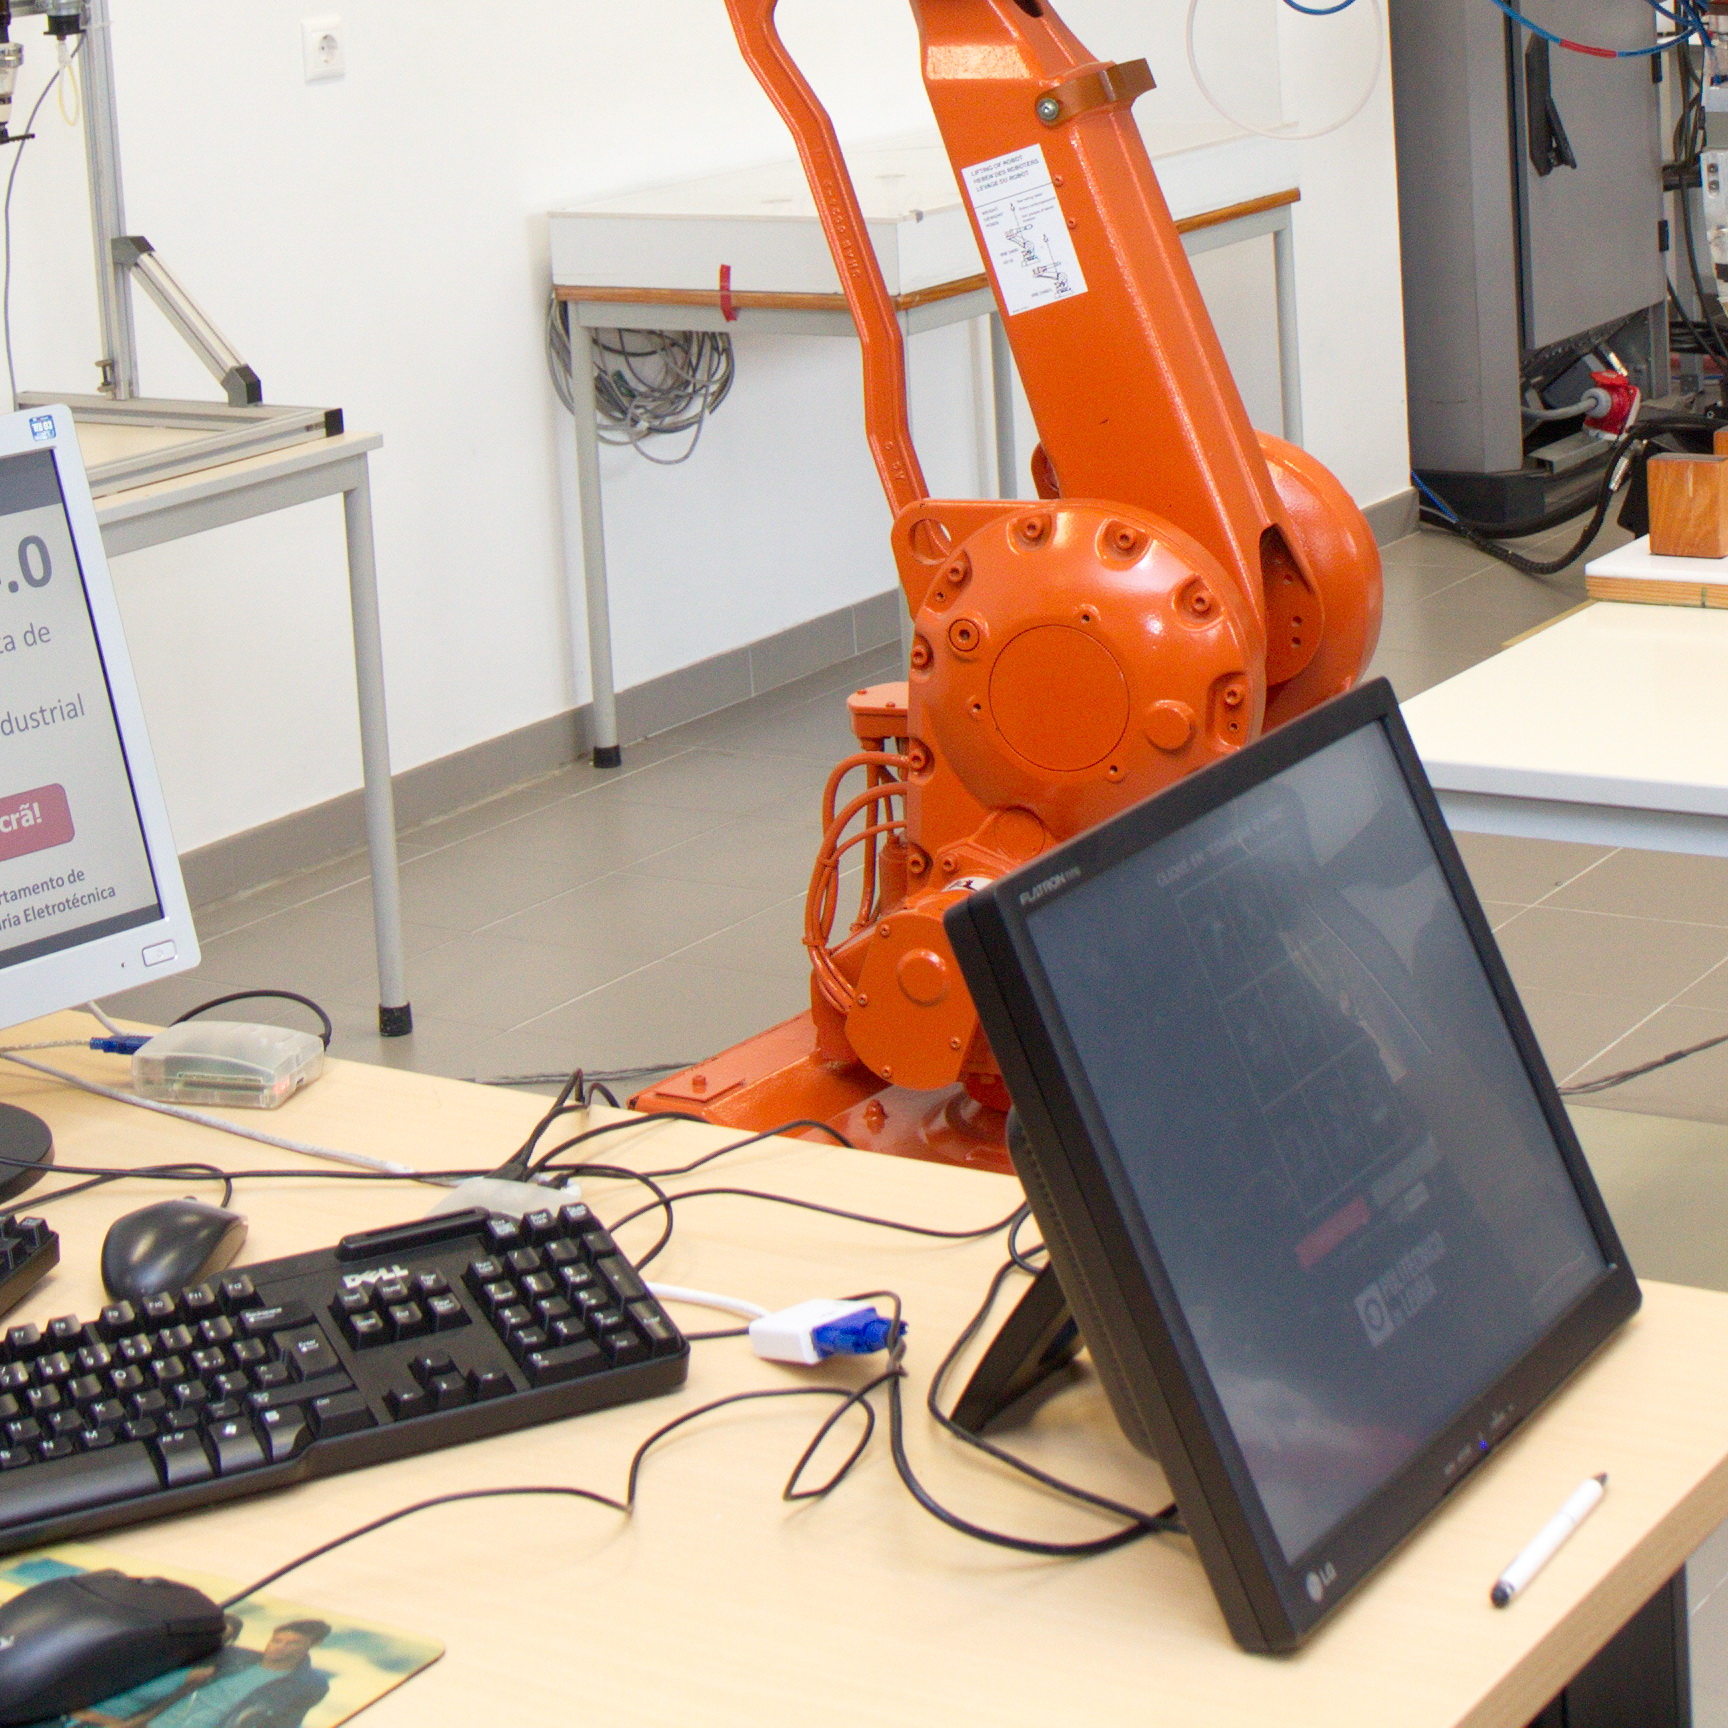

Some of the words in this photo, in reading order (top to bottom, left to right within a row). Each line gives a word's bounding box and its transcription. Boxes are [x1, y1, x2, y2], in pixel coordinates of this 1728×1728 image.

[23, 622, 52, 648] de
[67, 868, 85, 885] de
[1019, 873, 1066, 906] FLATRON
[23, 884, 117, 925] Eletrotécnica
[341, 1263, 409, 1289] DELL
[1320, 1561, 1337, 1587] LG
